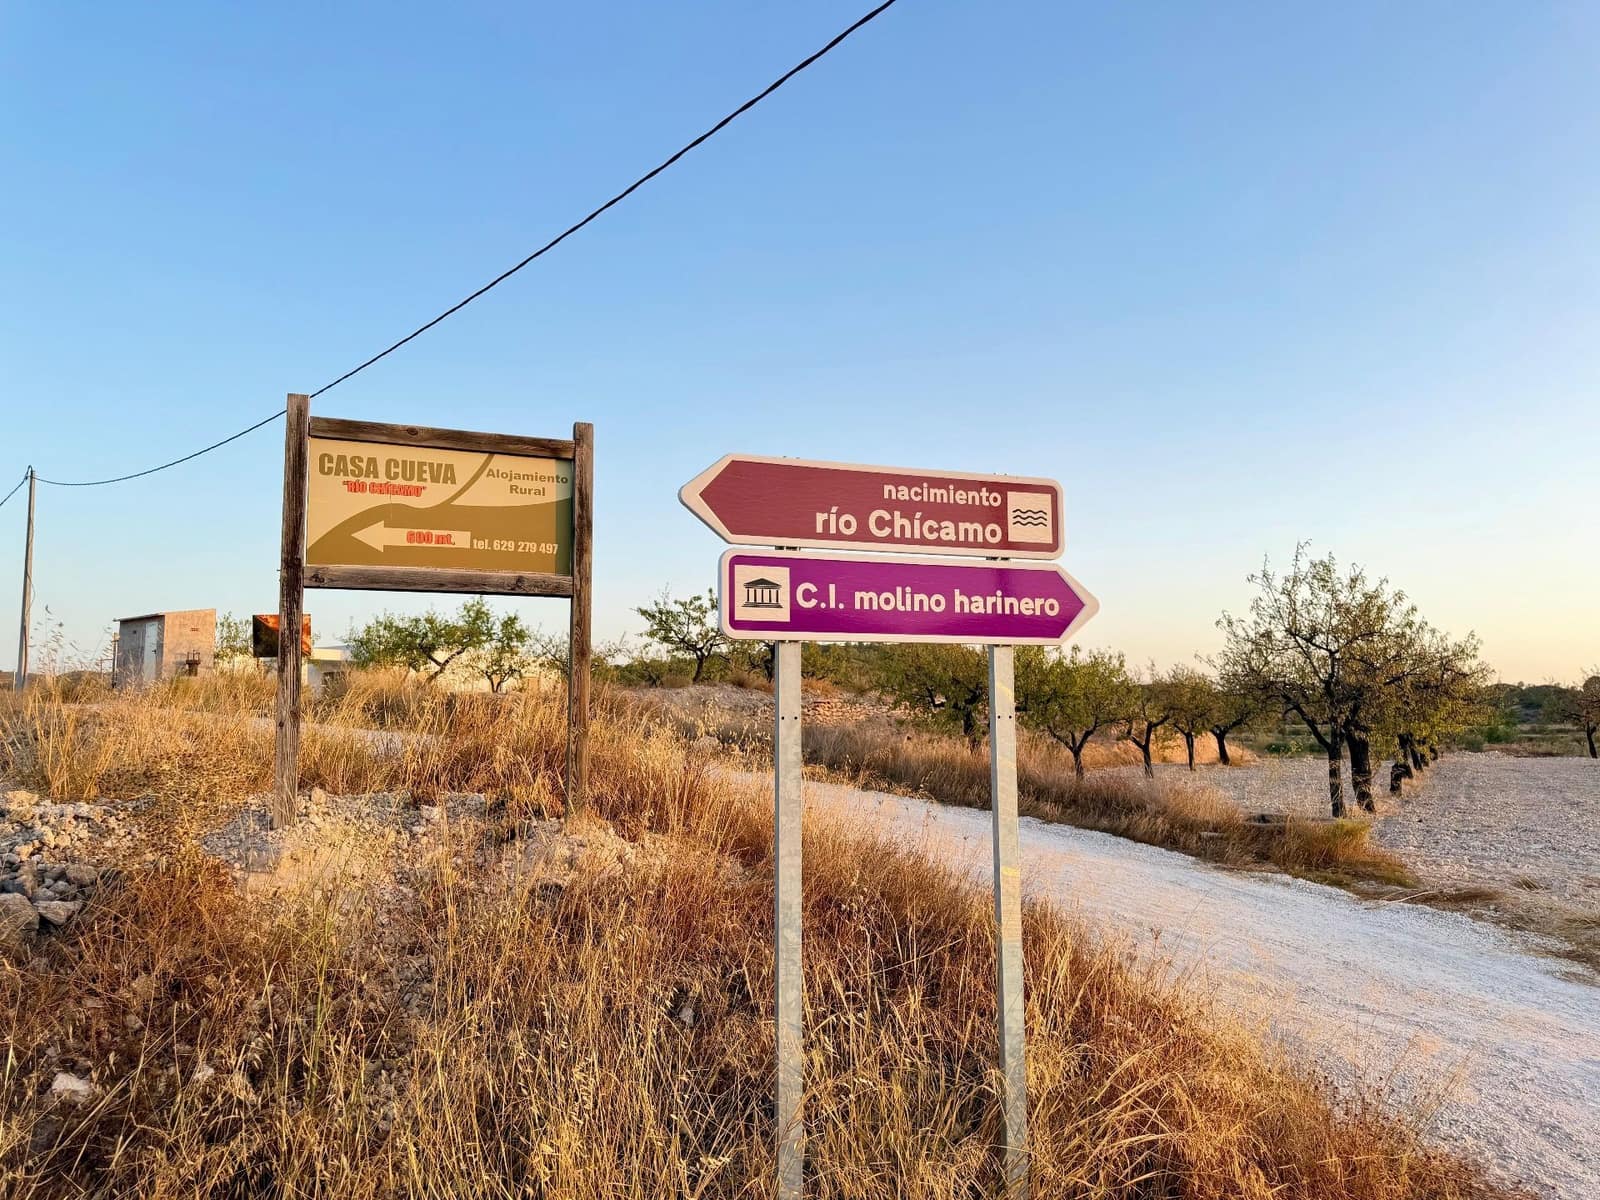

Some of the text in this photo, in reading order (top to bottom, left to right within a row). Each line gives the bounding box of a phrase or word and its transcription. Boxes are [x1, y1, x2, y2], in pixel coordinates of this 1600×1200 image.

[318, 453, 457, 485] CASA CUEVA
[486, 467, 569, 484] Alojamiento
[509, 484, 546, 497] Rural
[883, 483, 1002, 507] nacimiento
[816, 506, 1002, 544] río Chícamo
[473, 538, 559, 554] tel. 629 279 497
[854, 586, 946, 613] molino
[954, 590, 1060, 617] harinero
